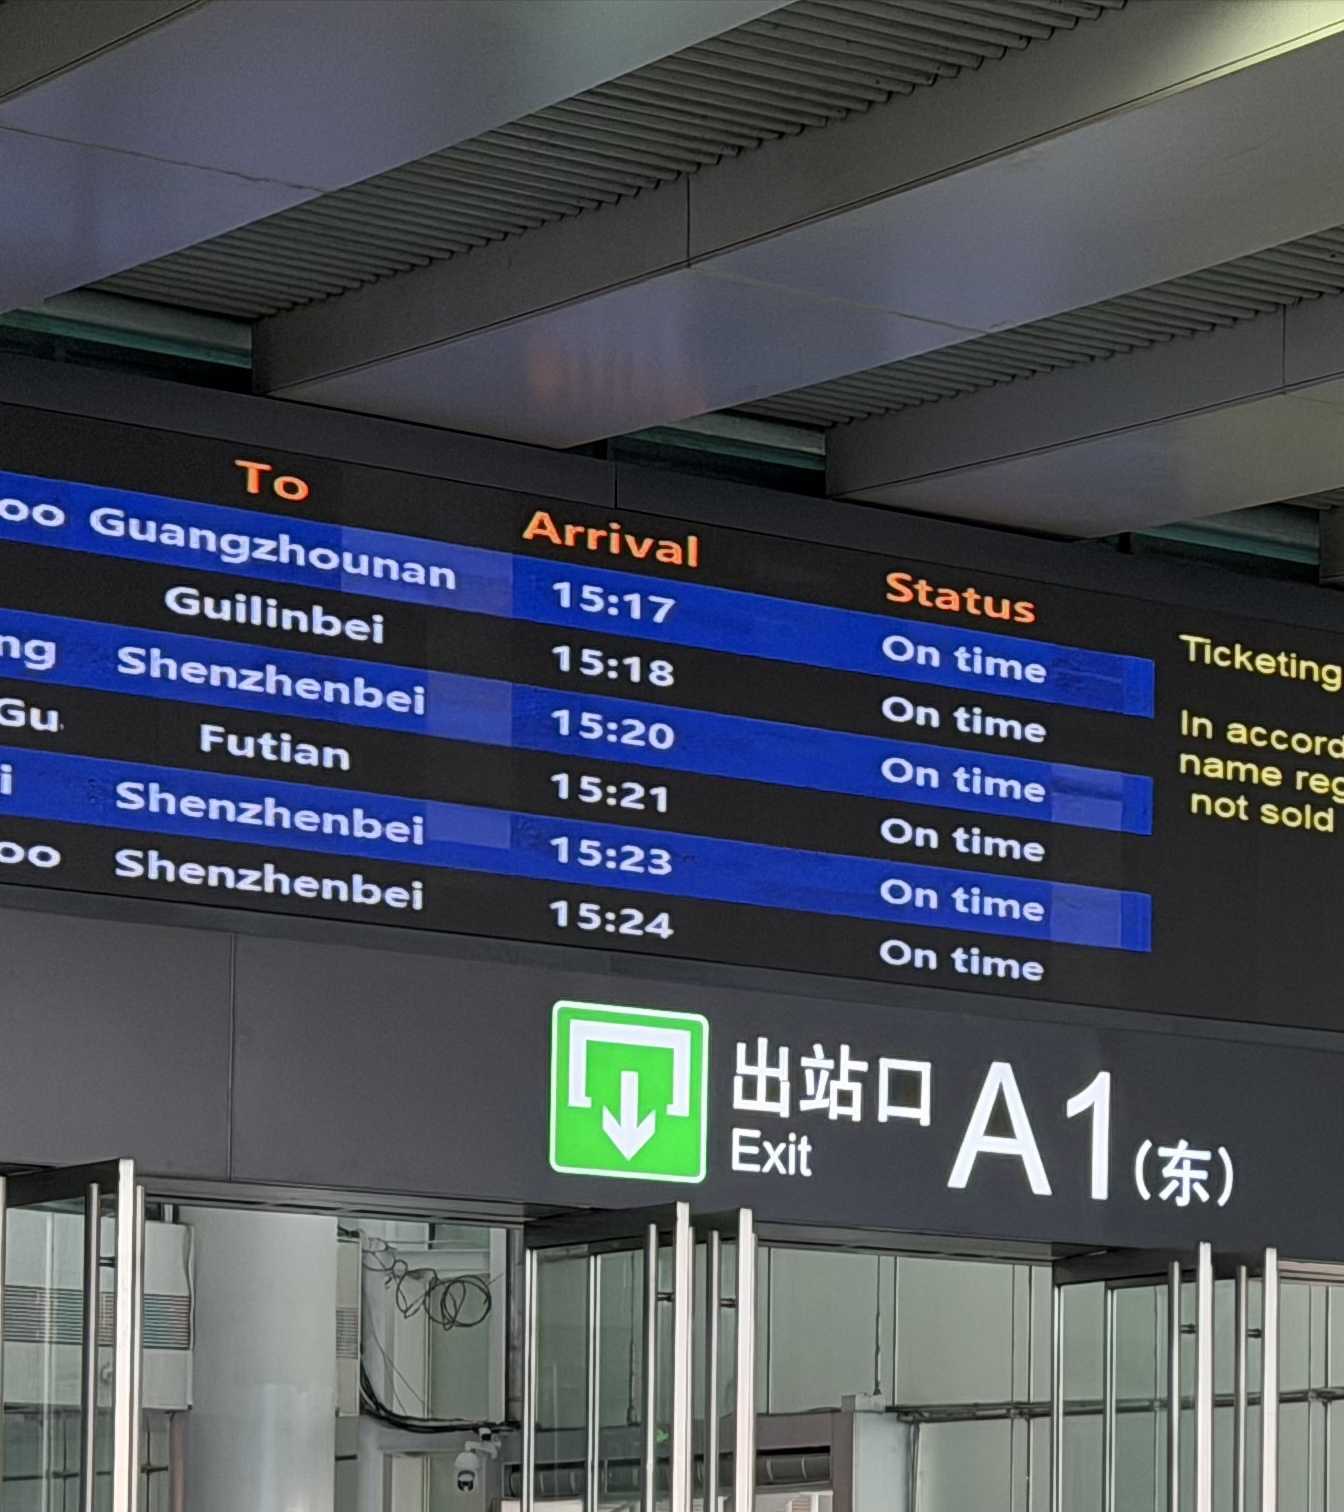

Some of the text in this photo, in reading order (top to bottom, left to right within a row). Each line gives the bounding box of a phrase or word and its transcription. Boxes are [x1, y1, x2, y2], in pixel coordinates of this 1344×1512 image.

[90, 508, 455, 589] Guangzhounan
[553, 582, 675, 623] 15:17
[883, 636, 939, 667] On
[954, 647, 1046, 683] time
[235, 460, 1035, 623] To Arrival Status
[118, 647, 424, 714] Shenzhenbei
[552, 710, 674, 749] 15:20
[882, 758, 938, 788] On
[953, 767, 1045, 802] time
[165, 587, 1046, 742] Guilinbei 15:18 On time
[1179, 635, 1341, 691] Ticketing
[1182, 710, 1212, 738] In
[201, 724, 349, 770] Futian
[551, 773, 666, 812] 15:21
[881, 818, 938, 848] On
[952, 828, 1045, 861] time
[1180, 754, 1282, 786] name
[1192, 793, 1248, 820] not
[1261, 804, 1333, 832] sold
[116, 850, 422, 910] Shenzhenbei
[550, 901, 674, 939] 15:24
[880, 940, 936, 969] On
[951, 948, 1044, 981] time
[117, 782, 423, 845] Shenzhenbei
[551, 837, 672, 875] 15:23
[881, 879, 937, 909] On
[952, 887, 1044, 921] time
[733, 1037, 931, 1126] 出站口
[948, 1062, 1110, 1200] A1
[732, 1128, 812, 1176] Exit
[1135, 1139, 1233, 1206] (东)
